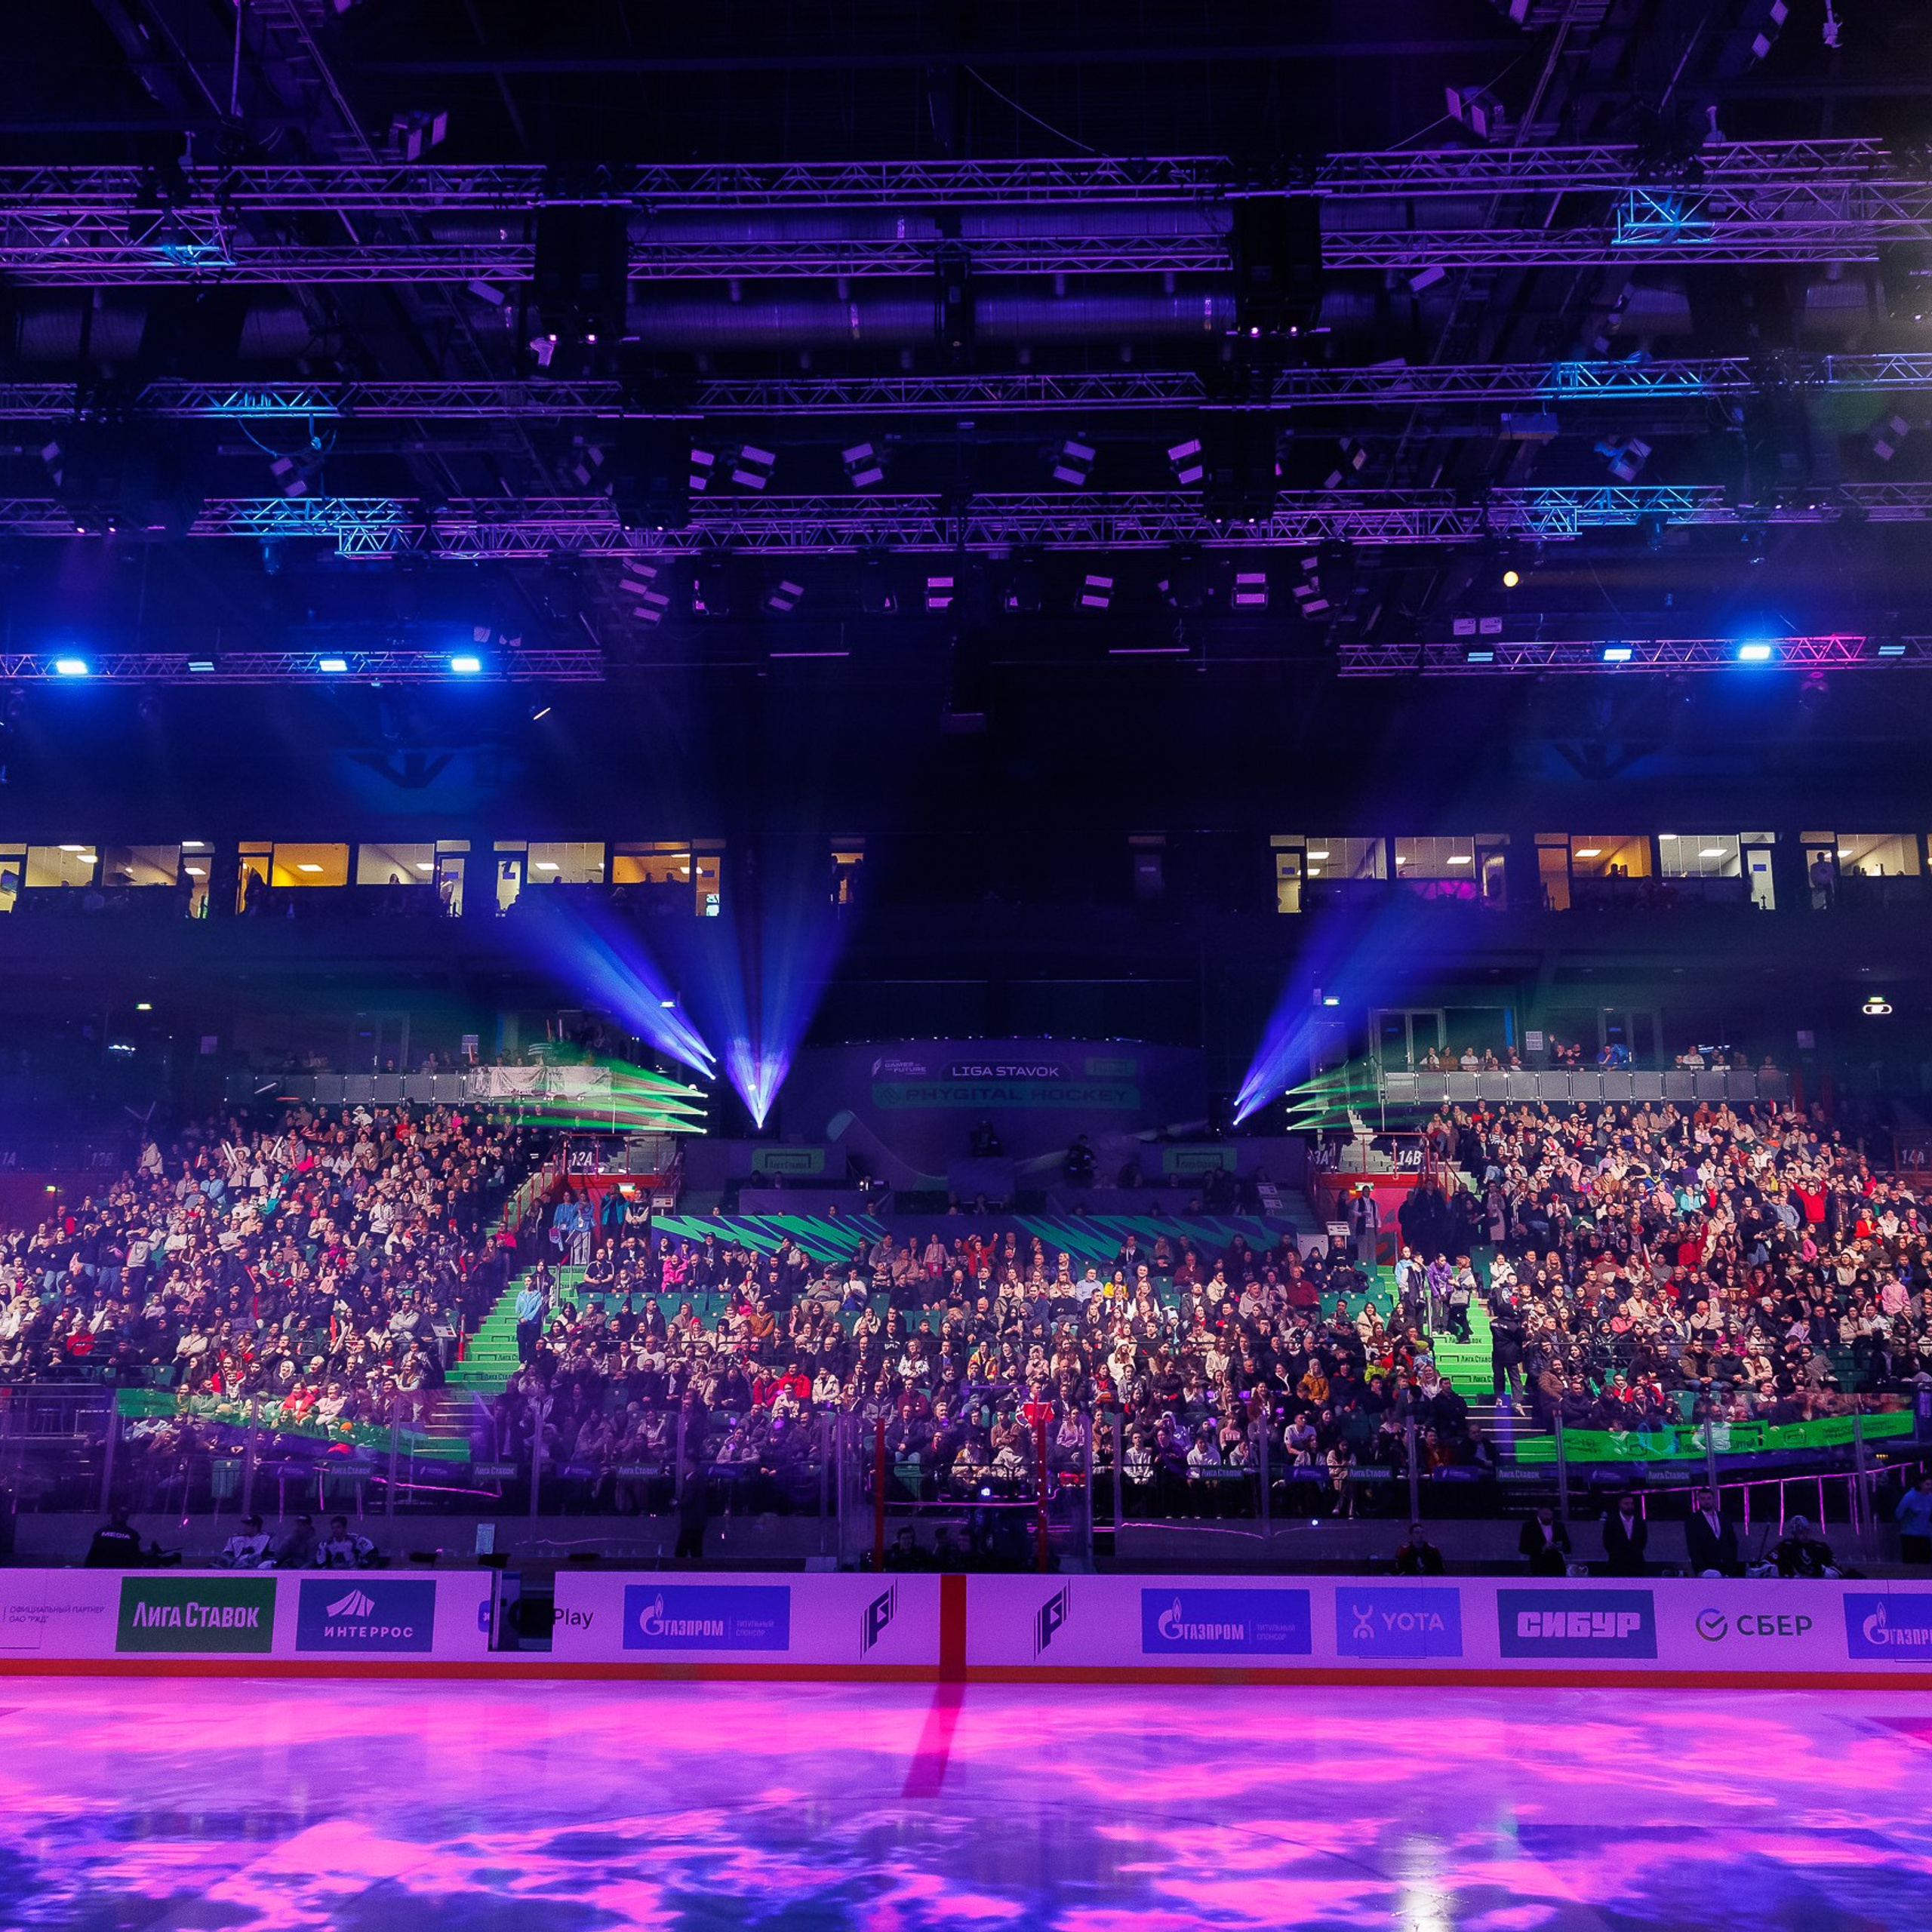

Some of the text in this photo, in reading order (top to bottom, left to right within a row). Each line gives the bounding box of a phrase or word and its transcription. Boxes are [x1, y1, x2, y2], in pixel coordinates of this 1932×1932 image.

[952, 1066, 1060, 1077] LIGA STAVOK
[906, 1088, 1127, 1102] PHYGITAL HOCKEY
[571, 1151, 592, 1166] 12A
[1398, 1150, 1422, 1165] 14B
[553, 1607, 594, 1630] Play
[1381, 1612, 1444, 1632] YOTA
[1517, 1611, 1641, 1638] СИБУР
[1737, 1614, 1813, 1637] СБЕР
[324, 1626, 414, 1638] ИНТЕРРОС
[664, 1620, 724, 1637] ГАЗПРОМ
[1183, 1624, 1244, 1641] ГАЗПРОМ
[1890, 1628, 1932, 1645] ГАЗПР
